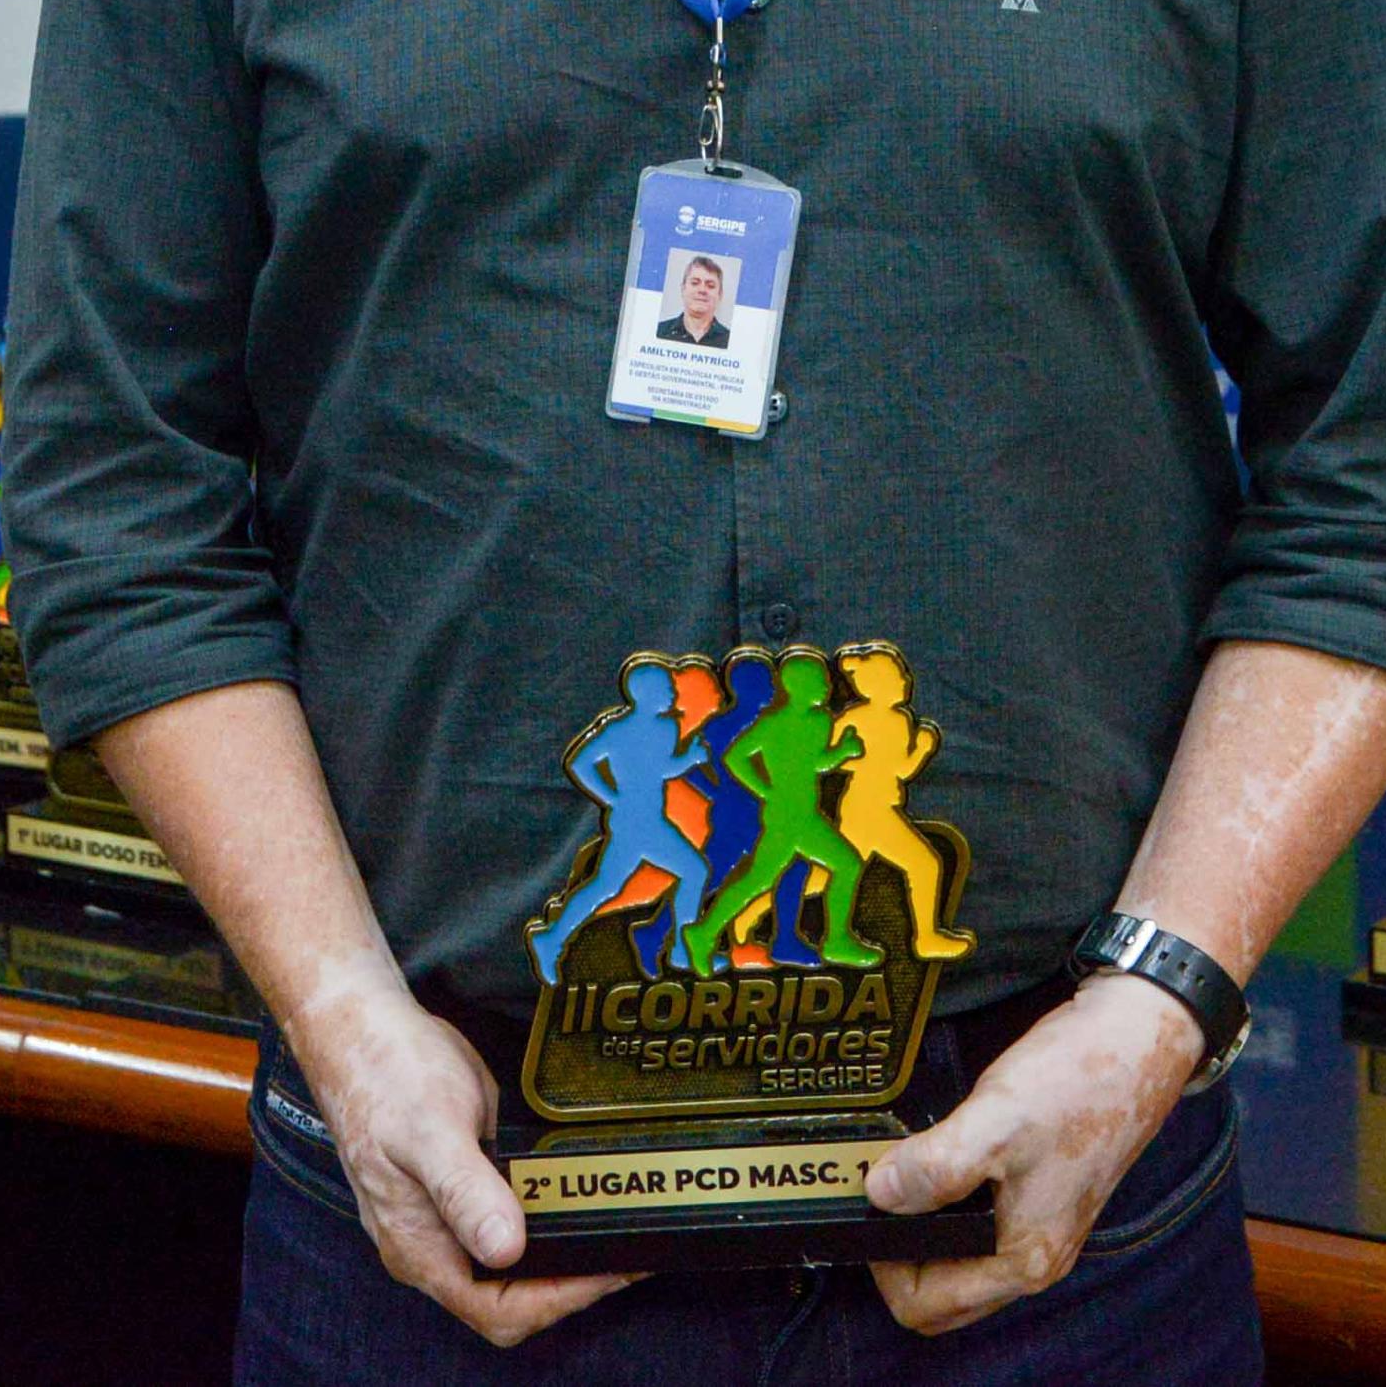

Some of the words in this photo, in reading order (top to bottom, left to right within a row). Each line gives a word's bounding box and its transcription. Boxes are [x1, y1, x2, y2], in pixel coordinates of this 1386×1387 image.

[697, 215, 747, 232] SERGIPE
[640, 345, 688, 361] AMILTON
[691, 353, 740, 369] PATRÍCIO
[33, 829, 82, 853] LUGAR
[86, 840, 136, 863] IDOSO
[600, 973, 892, 1033] CORRIDA
[601, 1036, 642, 1058] dos
[640, 1021, 892, 1071] servidores
[760, 1064, 886, 1094] SERGIPE
[560, 1166, 667, 1200] LUGAR
[675, 1165, 740, 1194] PCD
[749, 1161, 850, 1189] MASC.
